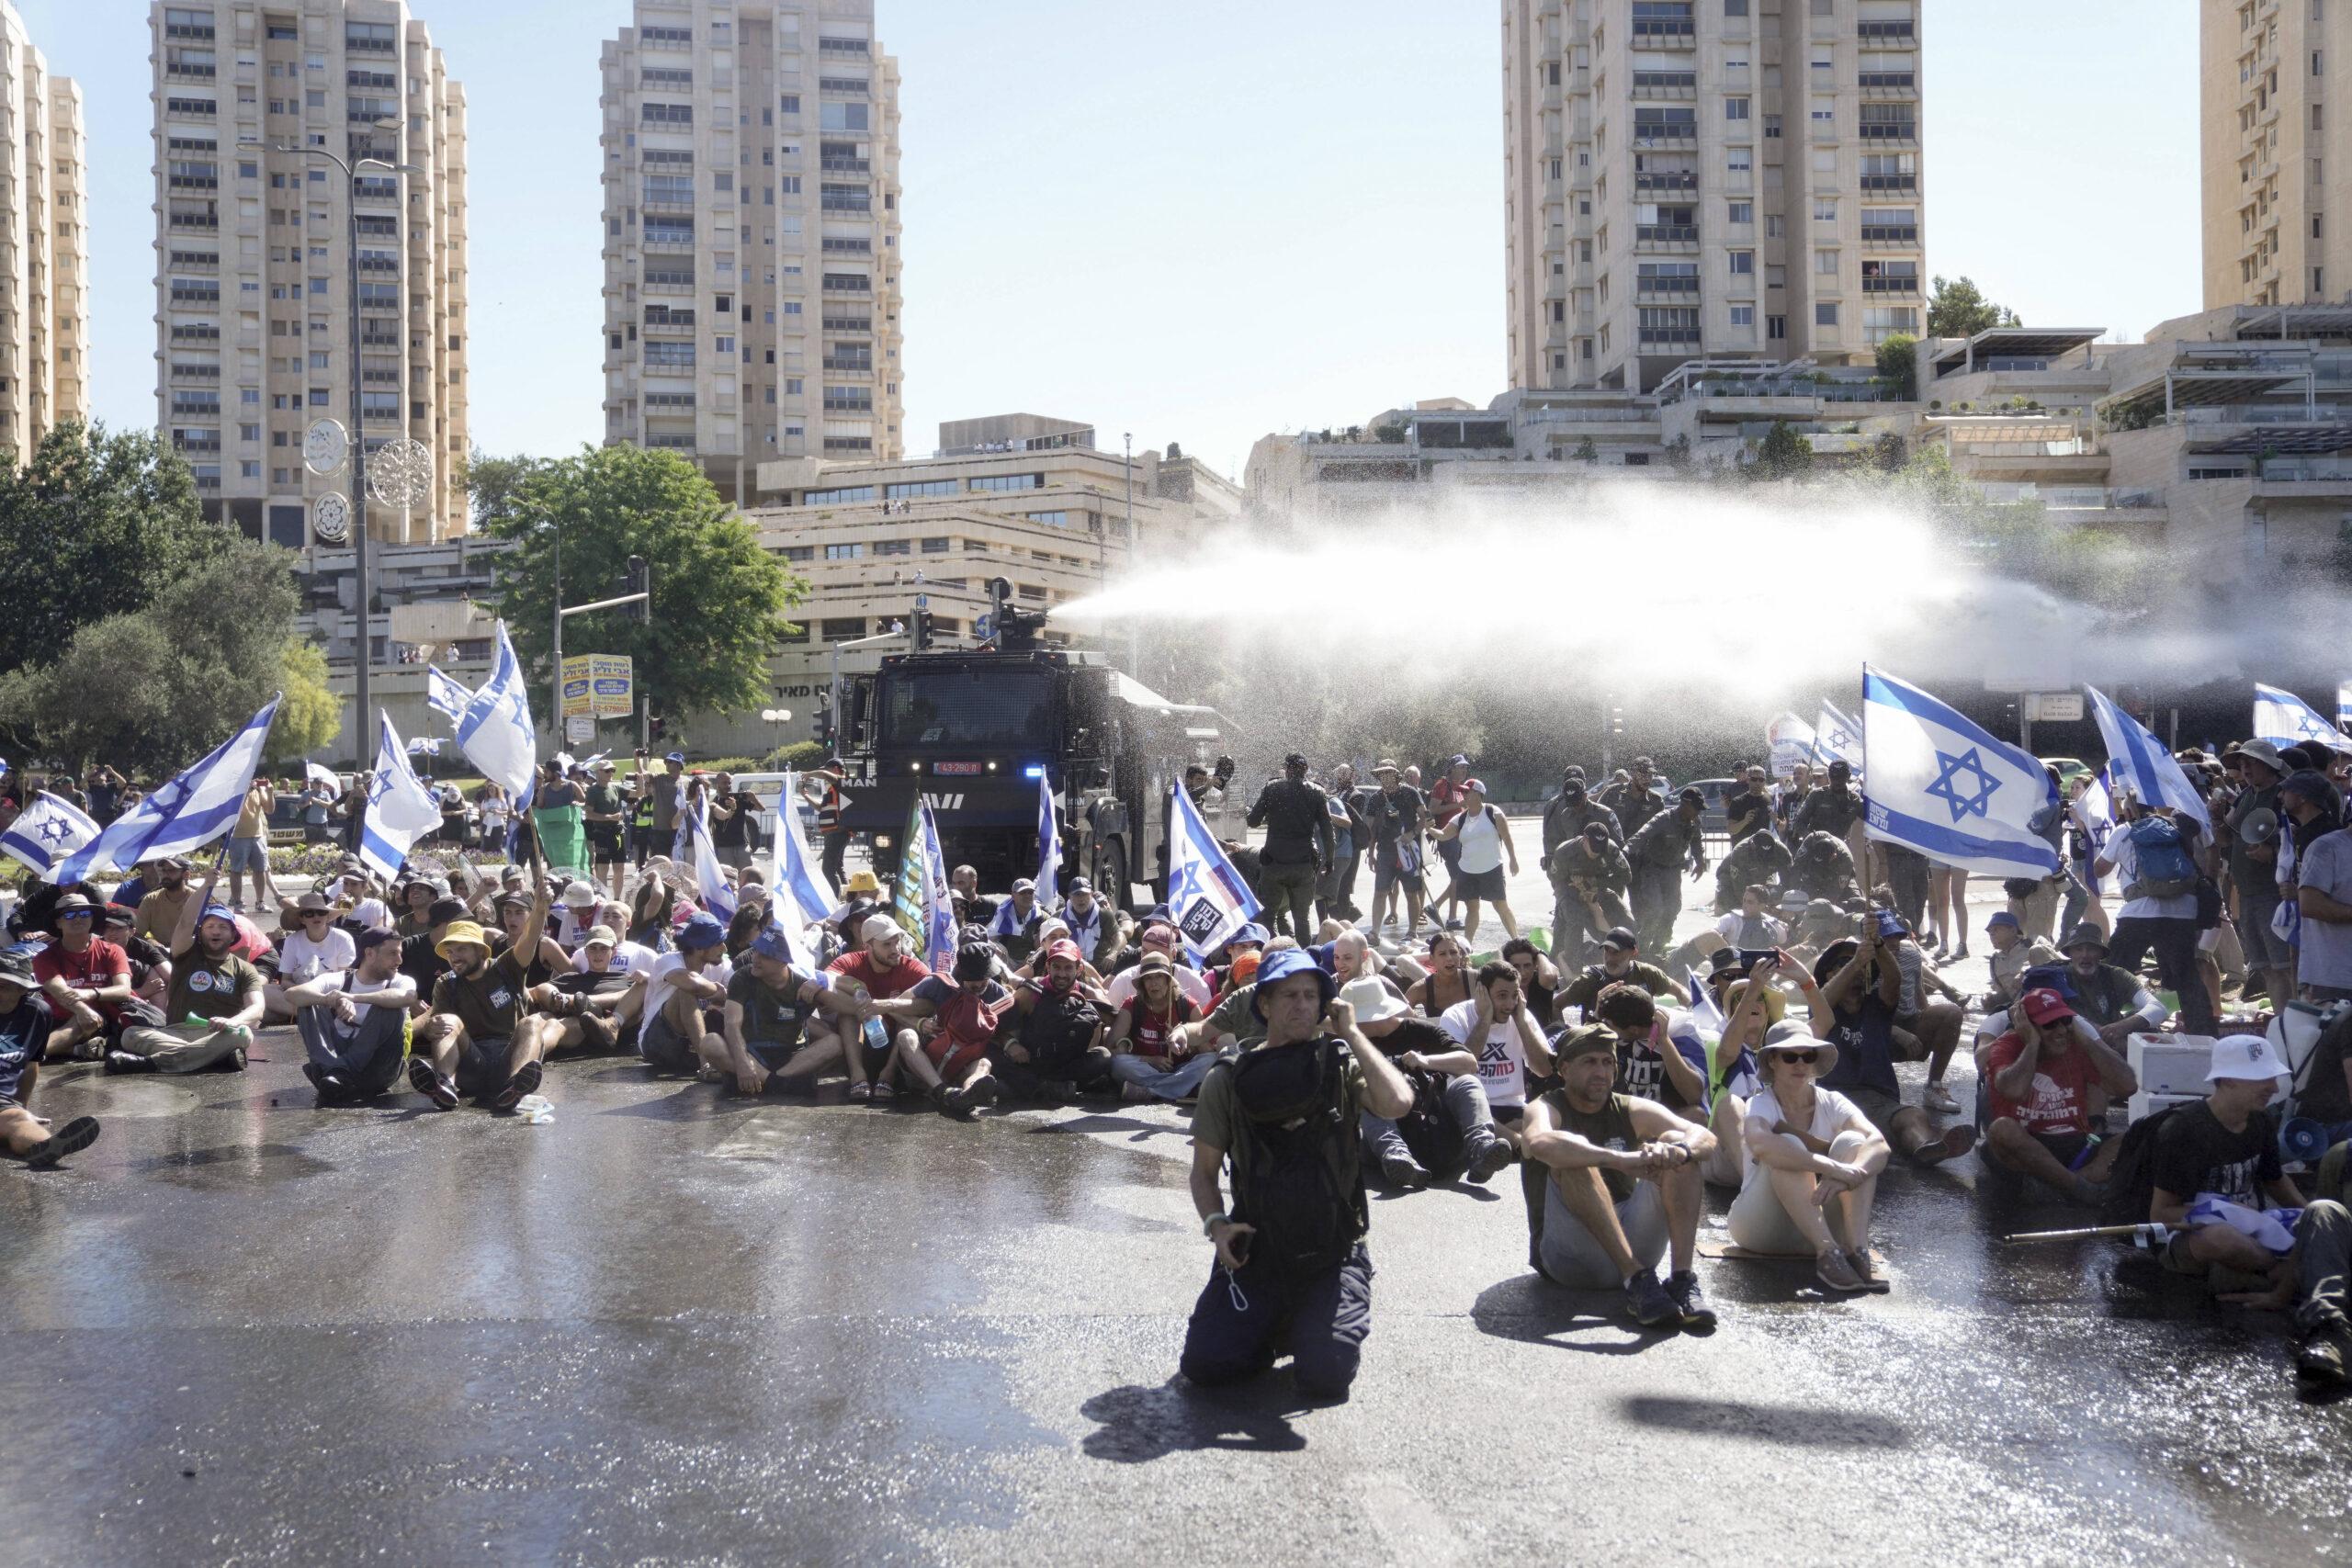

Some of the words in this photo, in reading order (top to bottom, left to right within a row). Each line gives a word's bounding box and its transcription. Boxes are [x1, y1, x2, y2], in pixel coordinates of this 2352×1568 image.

[775, 685, 810, 698] מאיר
[1779, 764, 1794, 773] מתה
[841, 779, 877, 787] MAN
[269, 829, 304, 839] משטר
